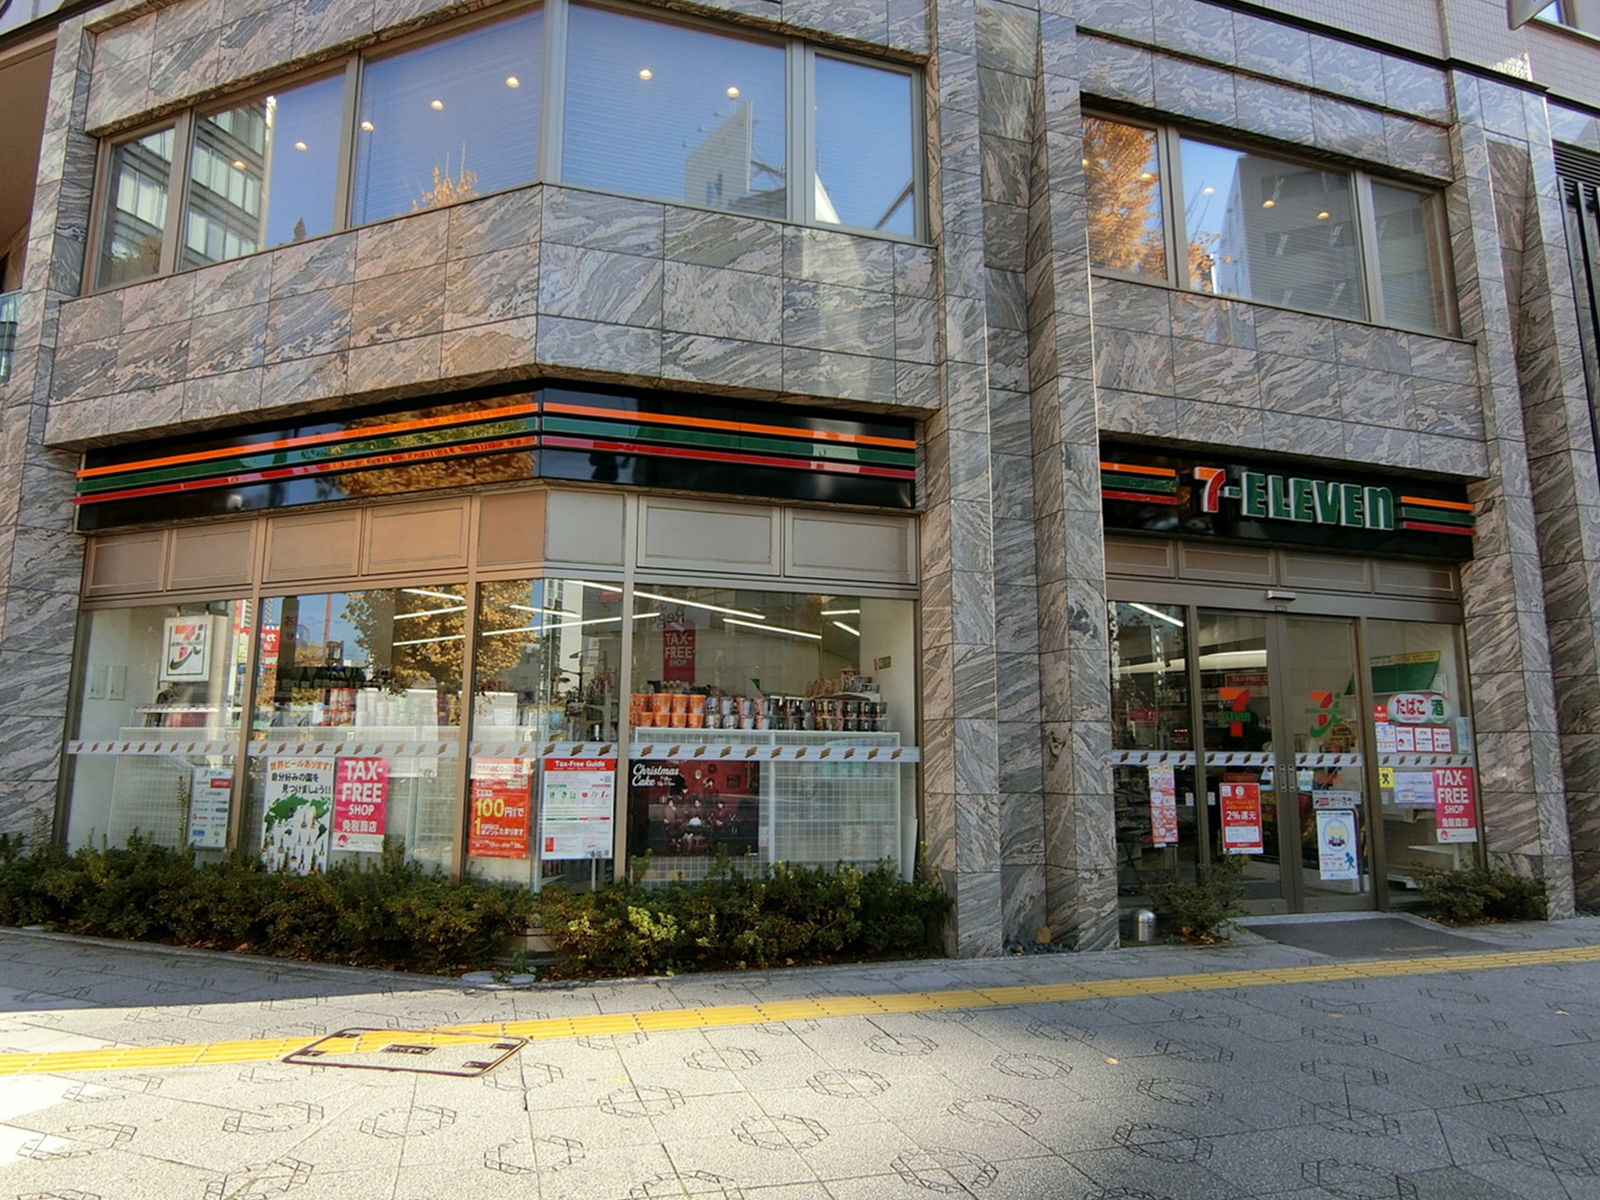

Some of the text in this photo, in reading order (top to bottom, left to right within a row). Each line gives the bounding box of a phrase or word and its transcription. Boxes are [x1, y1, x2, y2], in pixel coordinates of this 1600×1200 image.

[665, 632, 693, 646] TAX-
[664, 646, 693, 660] FREE
[669, 659, 688, 667] SHOP
[1395, 698, 1445, 716] たばこ 酒
[344, 760, 383, 780] TAX-
[555, 760, 605, 768] Tax-Free Guide
[633, 763, 680, 776] Christmas
[271, 772, 319, 782] 自分好みの国を
[631, 775, 656, 787] Cake
[1436, 769, 1467, 786] TAX-
[341, 782, 382, 803] FREE
[1437, 787, 1469, 804] FREE
[348, 804, 375, 816] SHOP
[1444, 804, 1464, 814] SHOP
